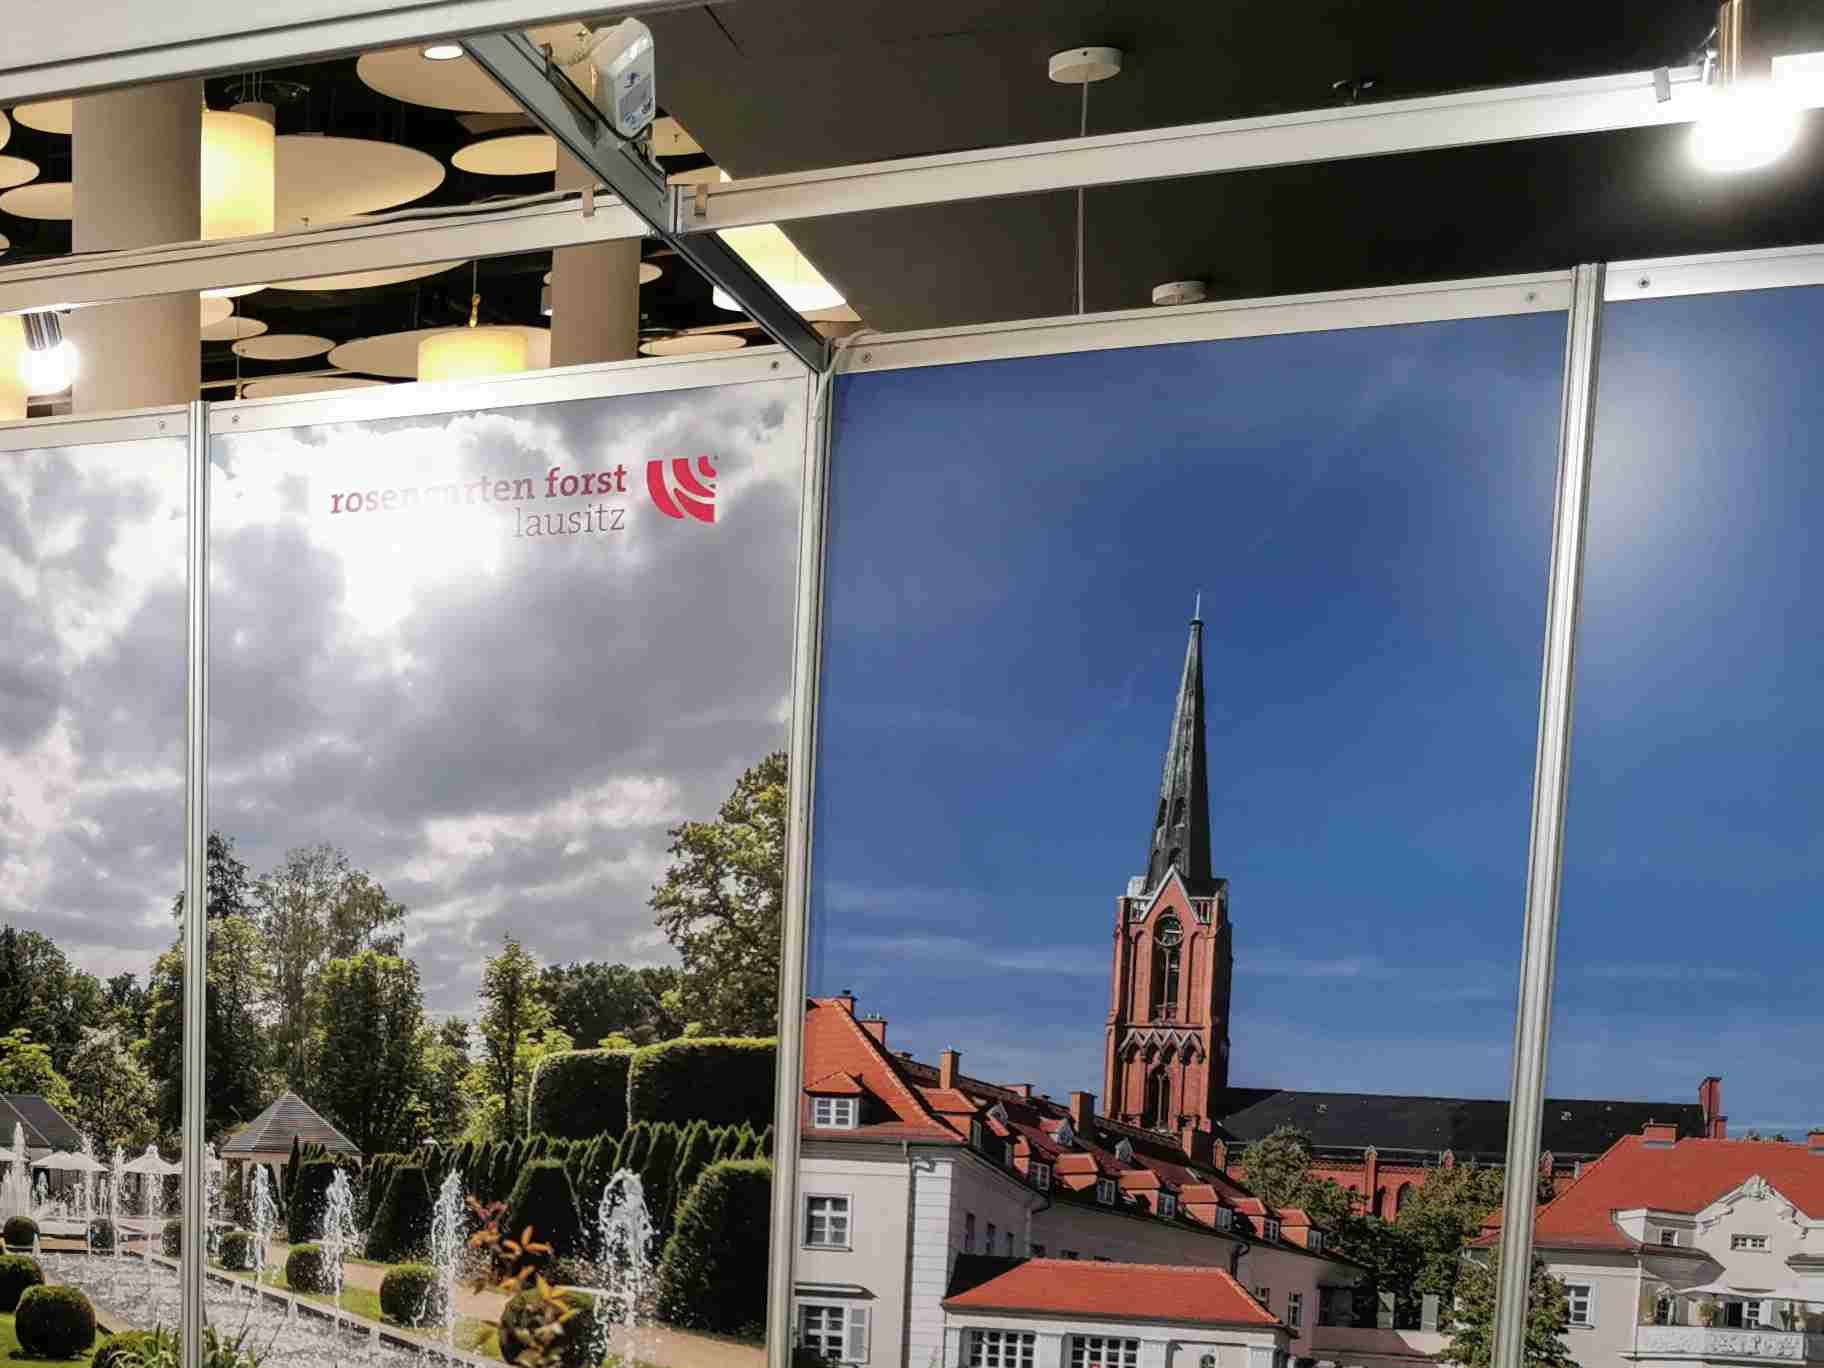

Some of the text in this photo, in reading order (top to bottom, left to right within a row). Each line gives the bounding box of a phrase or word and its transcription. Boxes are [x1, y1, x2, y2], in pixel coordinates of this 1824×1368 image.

[330, 463, 628, 514] rosenarten forst
[514, 503, 626, 538] lausitz
